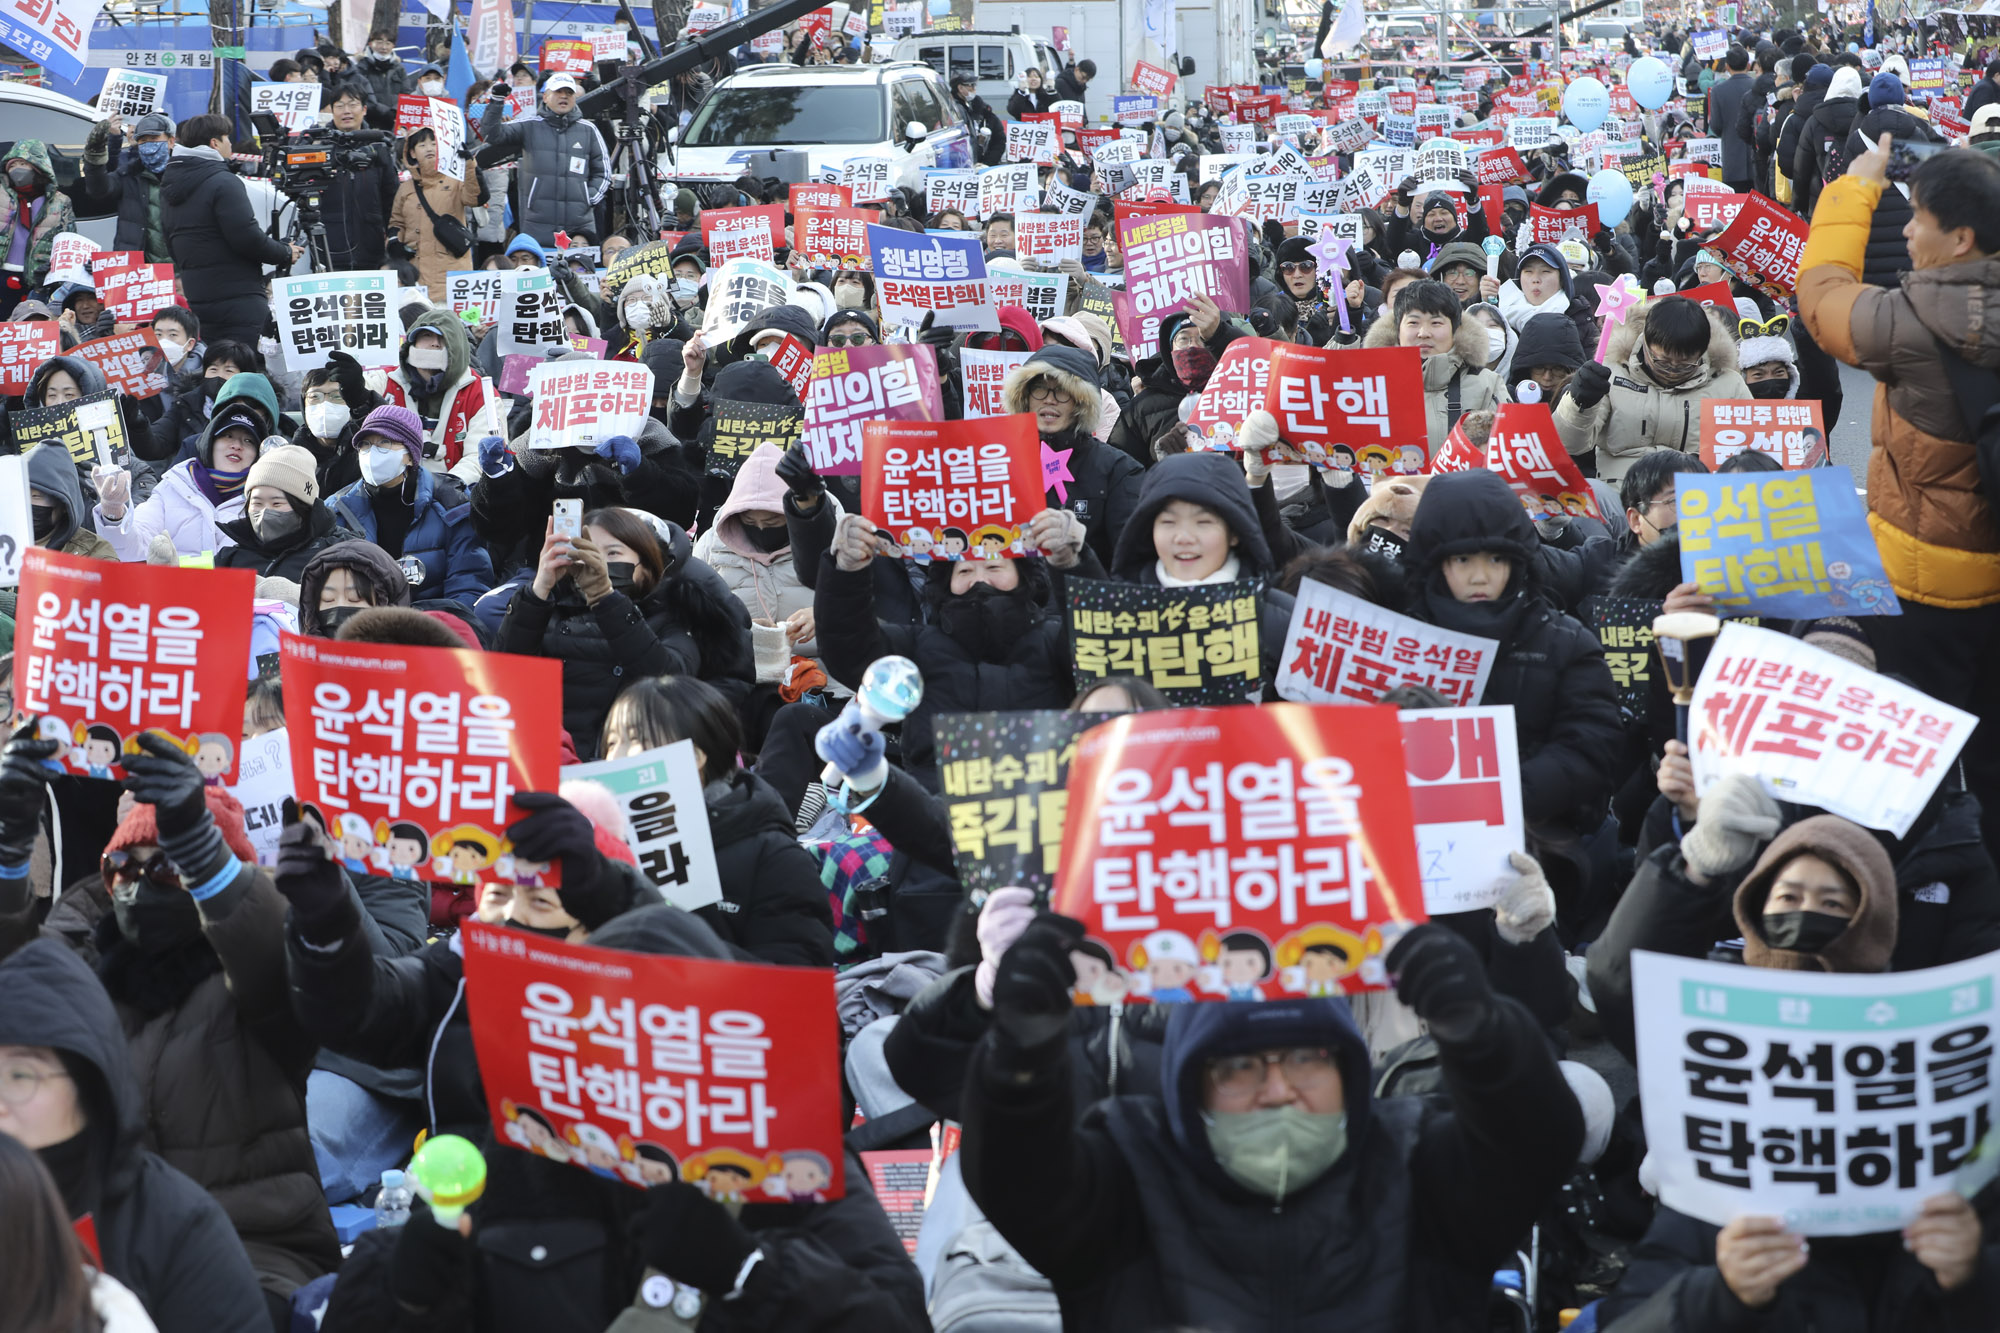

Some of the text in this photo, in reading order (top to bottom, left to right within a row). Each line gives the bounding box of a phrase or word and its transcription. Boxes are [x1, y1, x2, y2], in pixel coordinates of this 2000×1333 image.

[256, 90, 312, 111] 윤석열
[1243, 105, 1270, 121] 탄핵
[1009, 127, 1048, 146] 윤석열
[1332, 122, 1364, 143] 윤석열
[1009, 143, 1037, 161] 퇴진!
[1480, 156, 1512, 174] 윤석열을
[843, 163, 888, 187] 윤석열
[932, 178, 979, 199] 윤석열
[982, 171, 1030, 195] 윤석열
[1480, 168, 1518, 186] 탄핵하라
[796, 192, 842, 208] 윤석열을
[982, 193, 1016, 215] 퇴진!
[1248, 182, 1298, 201] 윤석열
[806, 217, 864, 236] 윤석열을
[1018, 219, 1080, 234] 내란범 윤석열
[1123, 215, 1188, 248] 내란공범
[1538, 214, 1588, 229] 윤석열을
[642, 246, 667, 260] 윤석열
[738, 232, 770, 250] 윤석열
[805, 236, 864, 254] 탄핵하라
[1018, 232, 1080, 256] 체포하라
[1127, 226, 1234, 277] 국민의힘
[881, 244, 970, 279] 청년명령
[127, 280, 174, 300] 윤석열
[882, 282, 985, 310] 윤석열 탄핵!
[1131, 264, 1217, 314] 해체!
[289, 292, 386, 326] 윤석열을
[291, 323, 388, 354] 탄핵하라
[541, 372, 648, 396] 내란범 윤석열
[966, 364, 1004, 382] 내란범
[536, 392, 647, 432] 체포하라
[1278, 374, 1392, 438] 탄핵
[1714, 405, 1812, 426] 반민주 반헌법
[16, 415, 68, 442] 내란수괴
[716, 418, 777, 435] 내란수괴
[889, 430, 938, 438] www.nanum.com
[1714, 430, 1806, 468] 윤석열
[883, 443, 1012, 486] 윤석열을
[883, 484, 1016, 528] 탄핵하라
[1678, 474, 1820, 553] 윤석열
[1368, 532, 1403, 560] 당장
[1694, 541, 1832, 606] 탄핵!
[34, 592, 204, 666] 윤석열을
[1073, 597, 1258, 636] 내란수괴 윤석열
[1302, 608, 1484, 675] 내란범 윤석열
[1600, 625, 1654, 648] 내란수
[318, 654, 406, 672] www.nanum.com
[1076, 621, 1260, 690] 즉각 탄핵
[1290, 637, 1474, 708] 체포하라
[26, 655, 200, 730] 탄핵하라
[1715, 656, 1954, 744] 내란범 윤석열
[311, 682, 516, 758] 윤석열을
[1697, 691, 1938, 778] 체포하라
[313, 747, 516, 825] 탄핵하라
[943, 750, 1056, 797] 내란수괴
[1098, 756, 1362, 847] 윤석열을
[1092, 842, 1375, 932] 탄핵하라
[528, 949, 632, 980] www.nanum.com
[520, 982, 771, 1080] 윤석열을
[1682, 1024, 1994, 1114] 윤석열을
[528, 1052, 777, 1149] 탄핵하라
[1684, 1102, 1991, 1196] 탄핵하라
